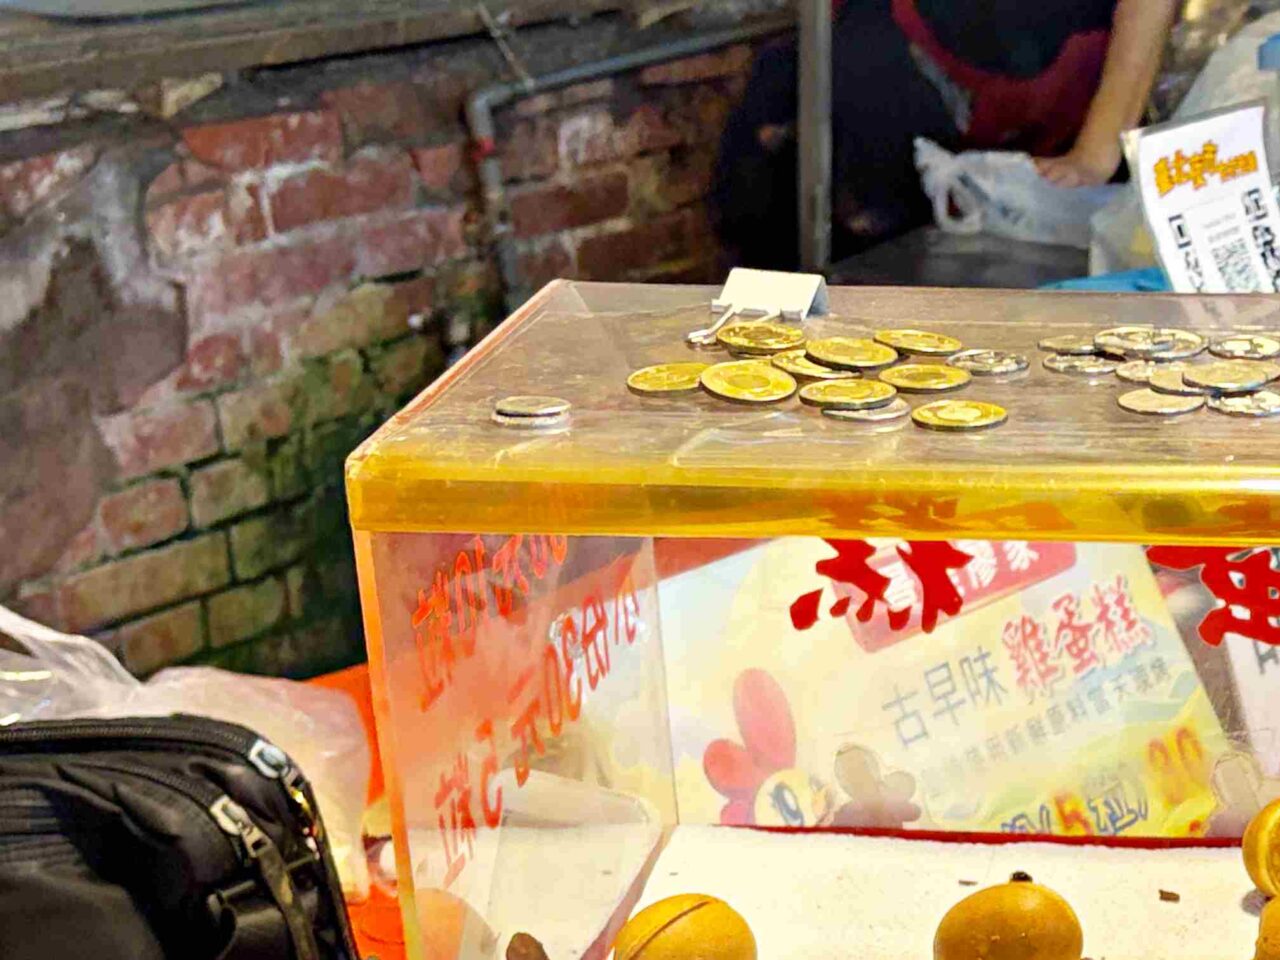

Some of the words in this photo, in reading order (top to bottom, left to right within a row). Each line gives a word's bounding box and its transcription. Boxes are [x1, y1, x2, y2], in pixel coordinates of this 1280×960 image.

[882, 574, 1157, 751] 古早味雞蛋糕
